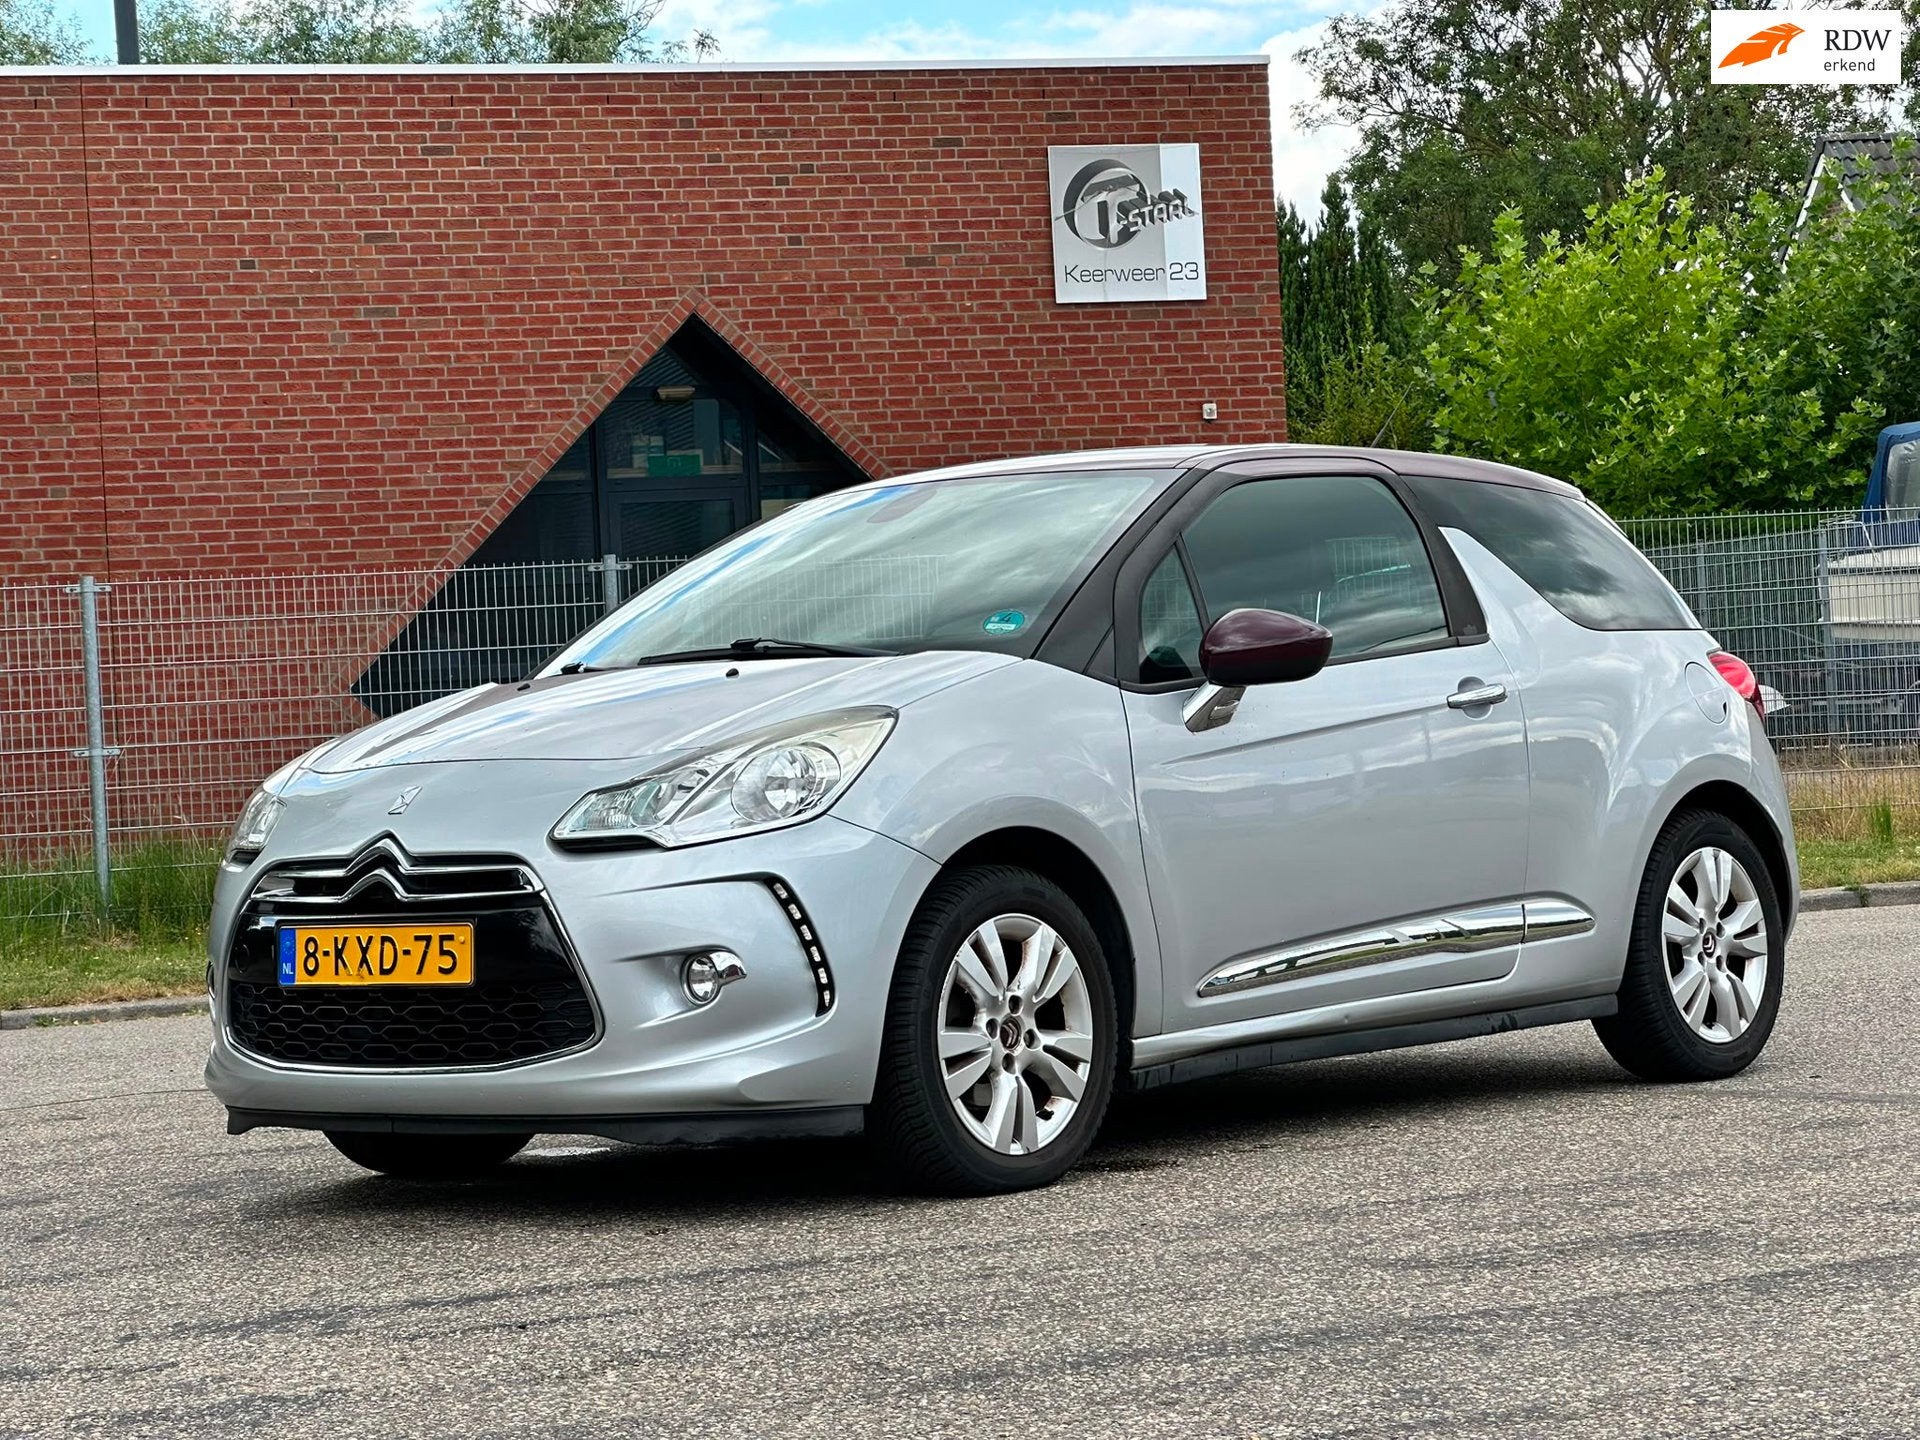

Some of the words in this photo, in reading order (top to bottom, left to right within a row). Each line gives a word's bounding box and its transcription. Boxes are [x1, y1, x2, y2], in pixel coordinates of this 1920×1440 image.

[1064, 264, 1166, 284] Keerweer
[1169, 261, 1199, 281] 23
[303, 933, 458, 977] 8-KXD-75
[282, 962, 294, 975] NL
